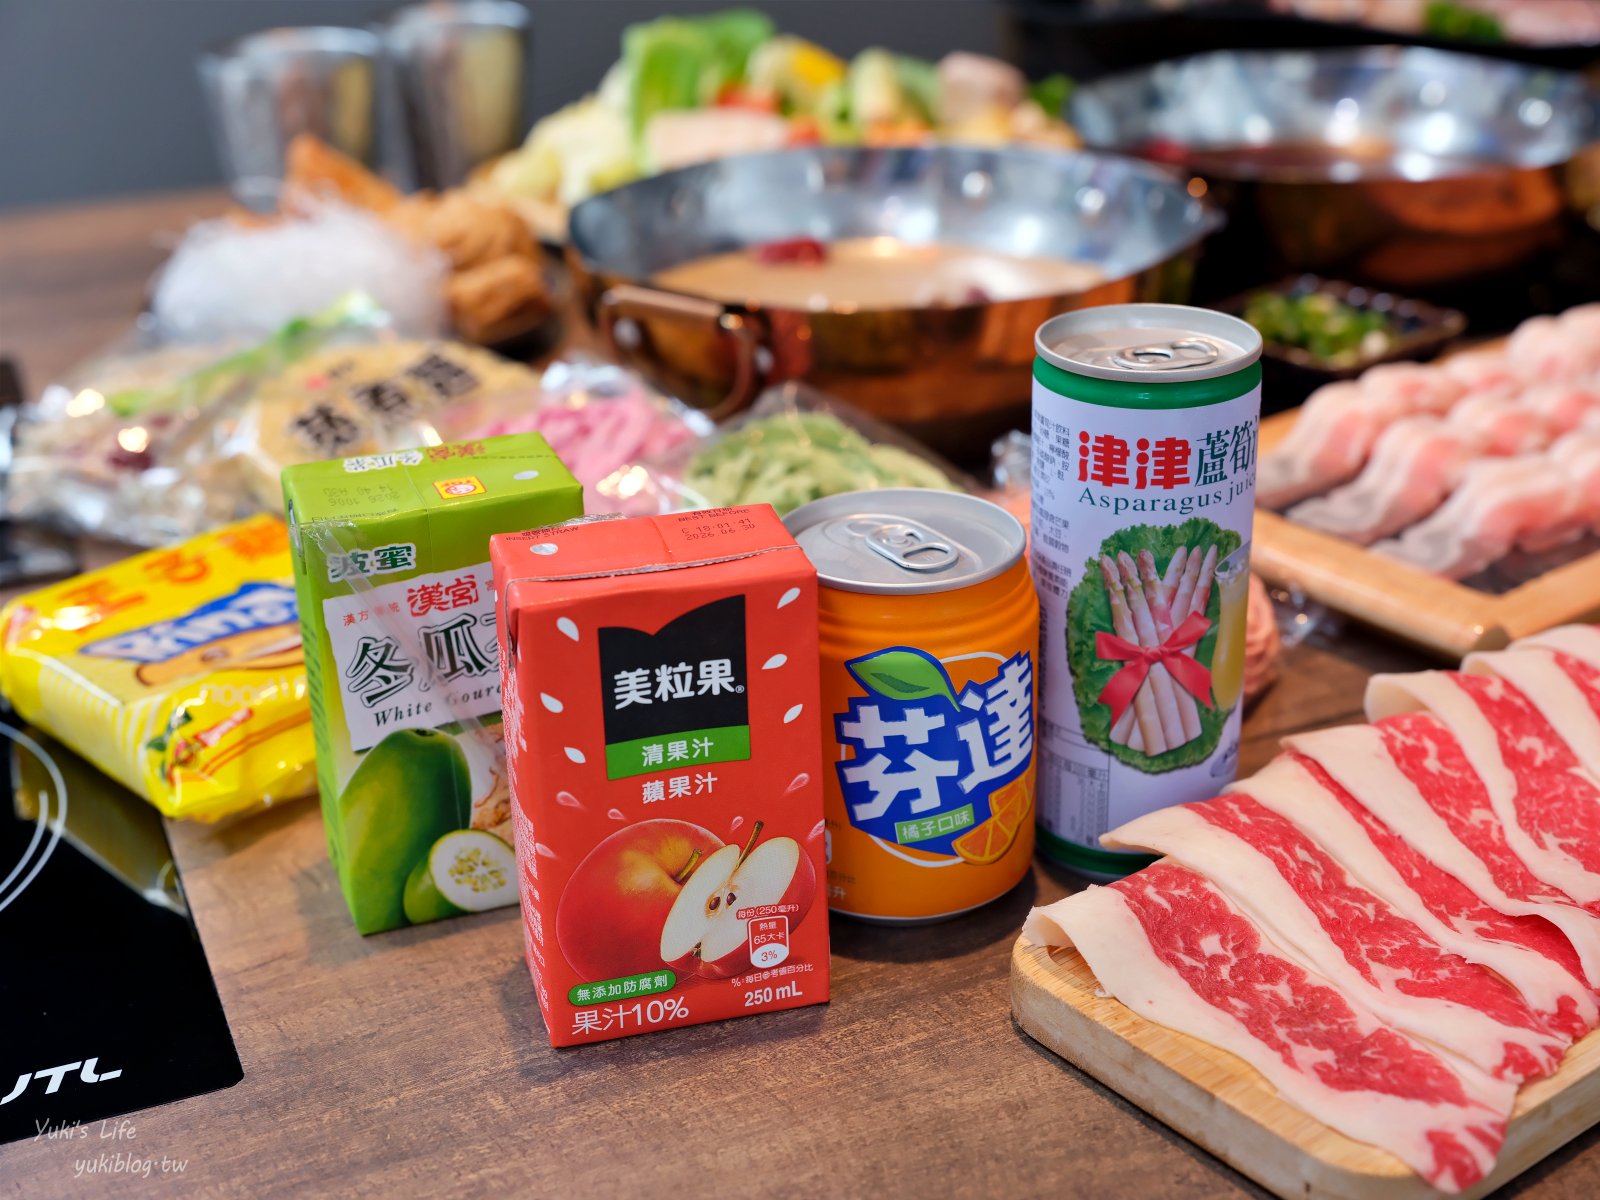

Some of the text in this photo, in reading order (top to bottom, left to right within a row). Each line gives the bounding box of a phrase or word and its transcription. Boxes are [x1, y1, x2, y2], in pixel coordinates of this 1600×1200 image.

[1078, 486, 1228, 515] Asparagus
[1225, 470, 1257, 506] juic
[407, 574, 479, 617] 漢宮
[346, 612, 501, 708] 冬瓜
[374, 701, 433, 727] White
[641, 736, 715, 767] 清果汁
[841, 655, 1033, 822] 芬達
[641, 771, 718, 804] 蘋果汁
[753, 931, 785, 945] 65大卡
[761, 949, 778, 962] 3%
[576, 974, 668, 1002] 無添加防腐劑
[744, 980, 803, 1007] 250 mL
[571, 996, 690, 1035] 果汁10%
